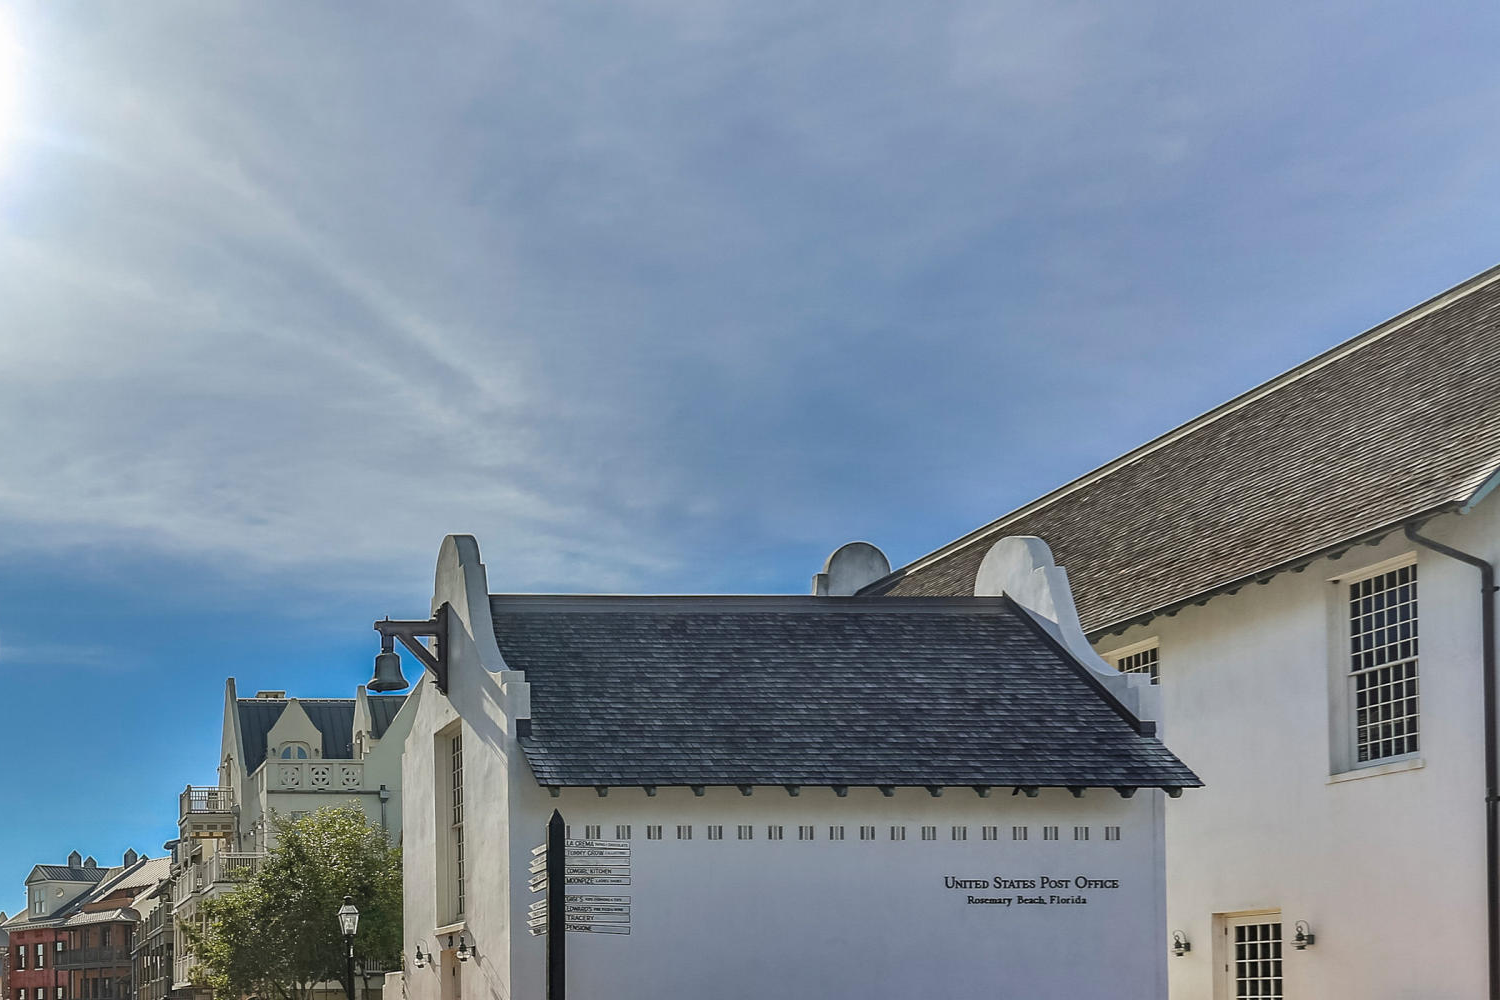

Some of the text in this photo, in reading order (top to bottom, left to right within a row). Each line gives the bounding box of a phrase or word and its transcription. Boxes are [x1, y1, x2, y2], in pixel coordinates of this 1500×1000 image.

[967, 895, 1087, 907] Rosemary Beach, Florida
